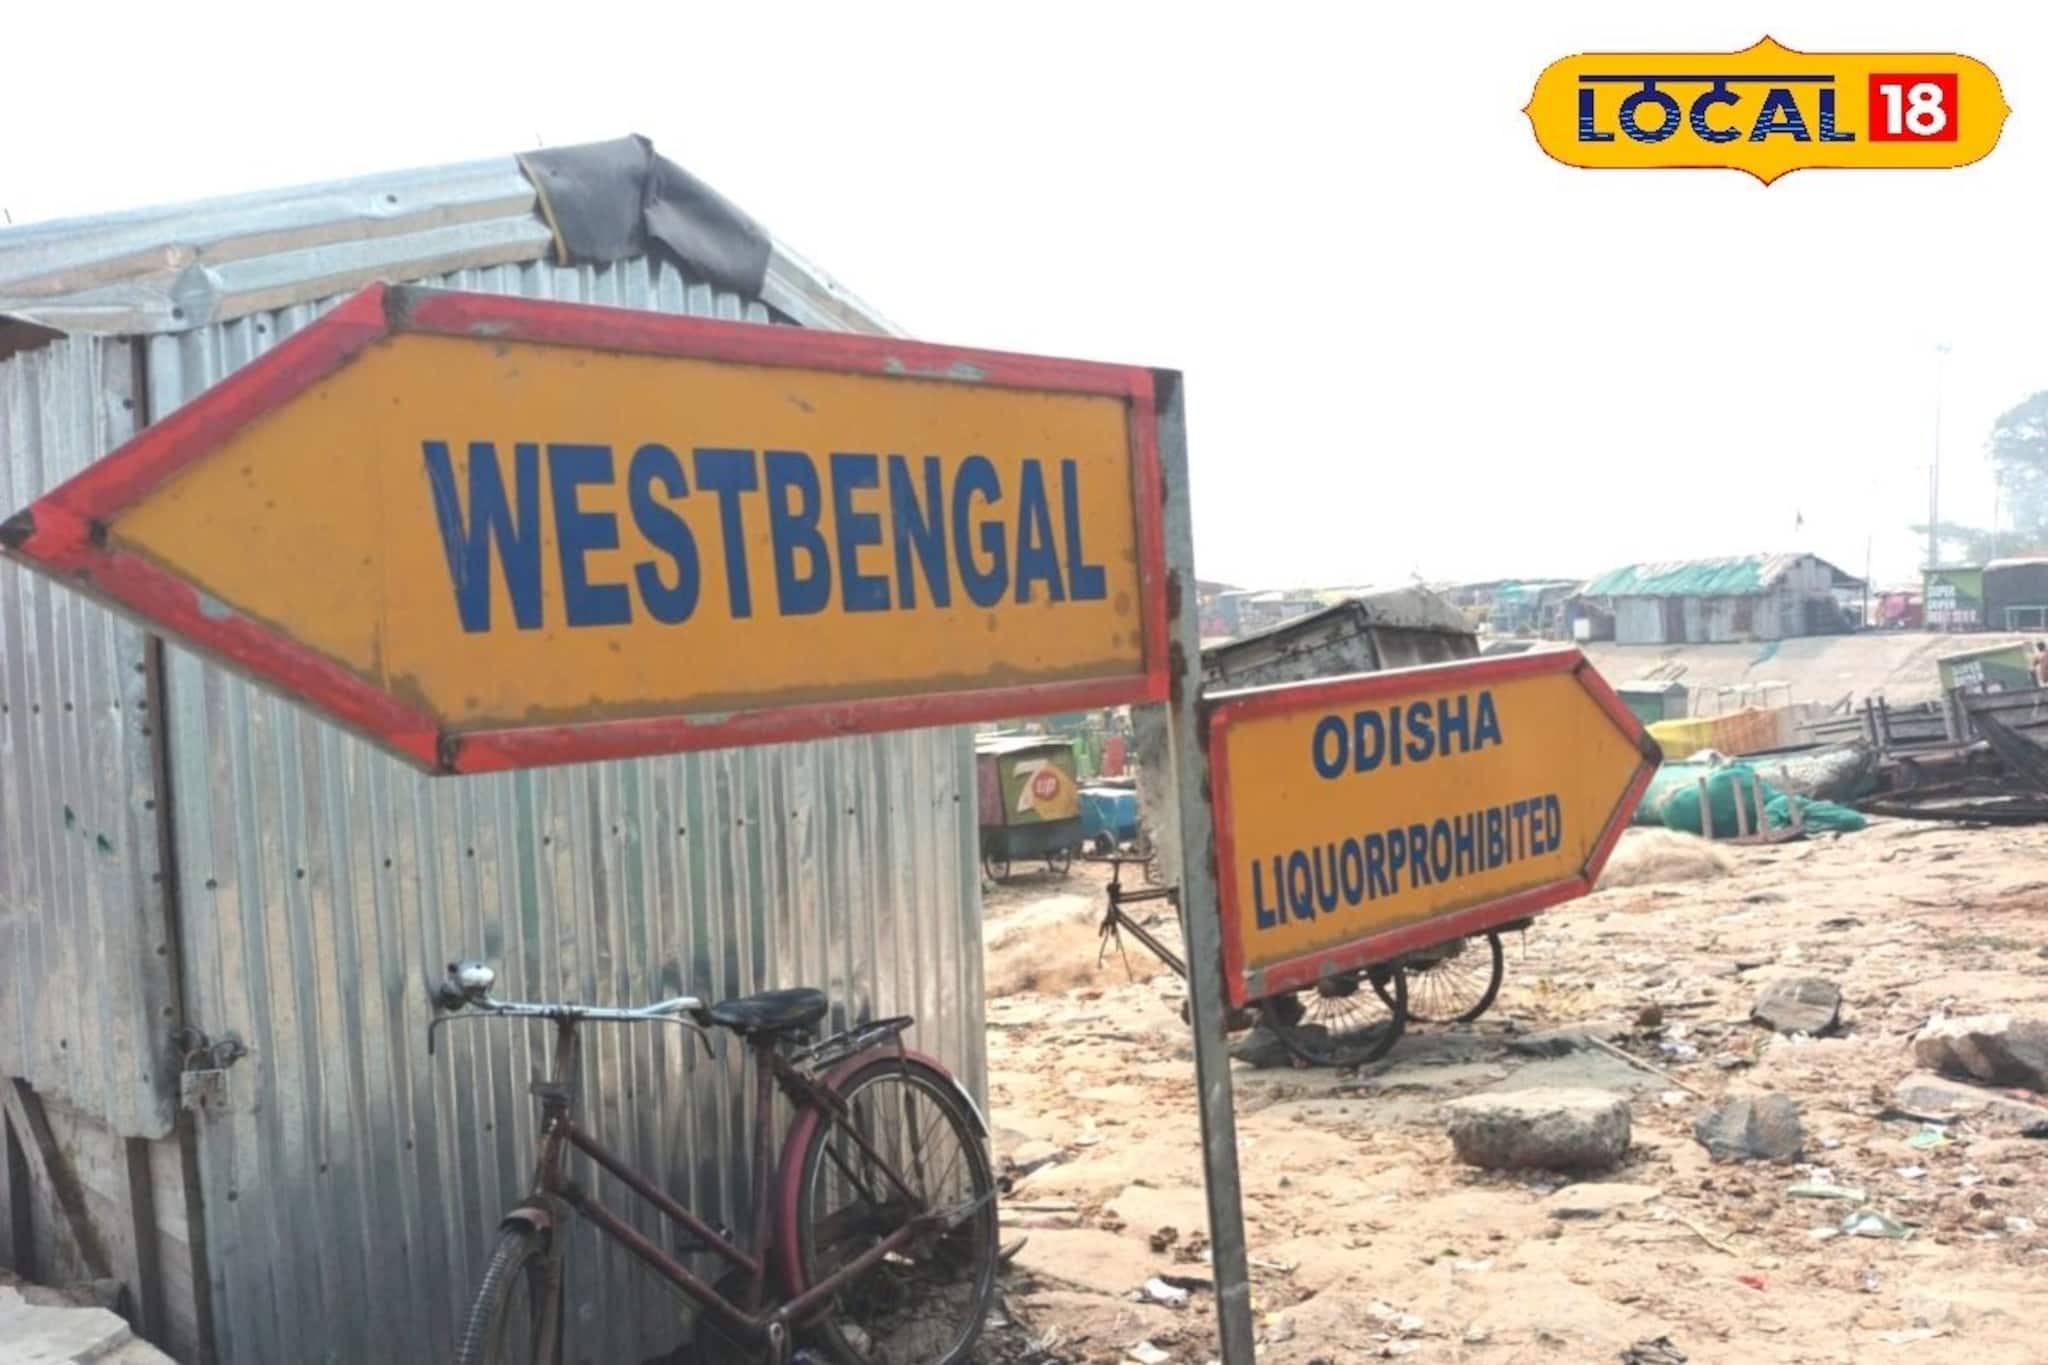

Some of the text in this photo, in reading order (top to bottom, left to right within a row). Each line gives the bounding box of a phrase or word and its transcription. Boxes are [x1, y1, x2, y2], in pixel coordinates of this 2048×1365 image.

[422, 441, 1107, 633] WESTBENGAL
[1312, 690, 1503, 779] ODISHA
[1251, 794, 1562, 930] LIQUORPROHIBITED
